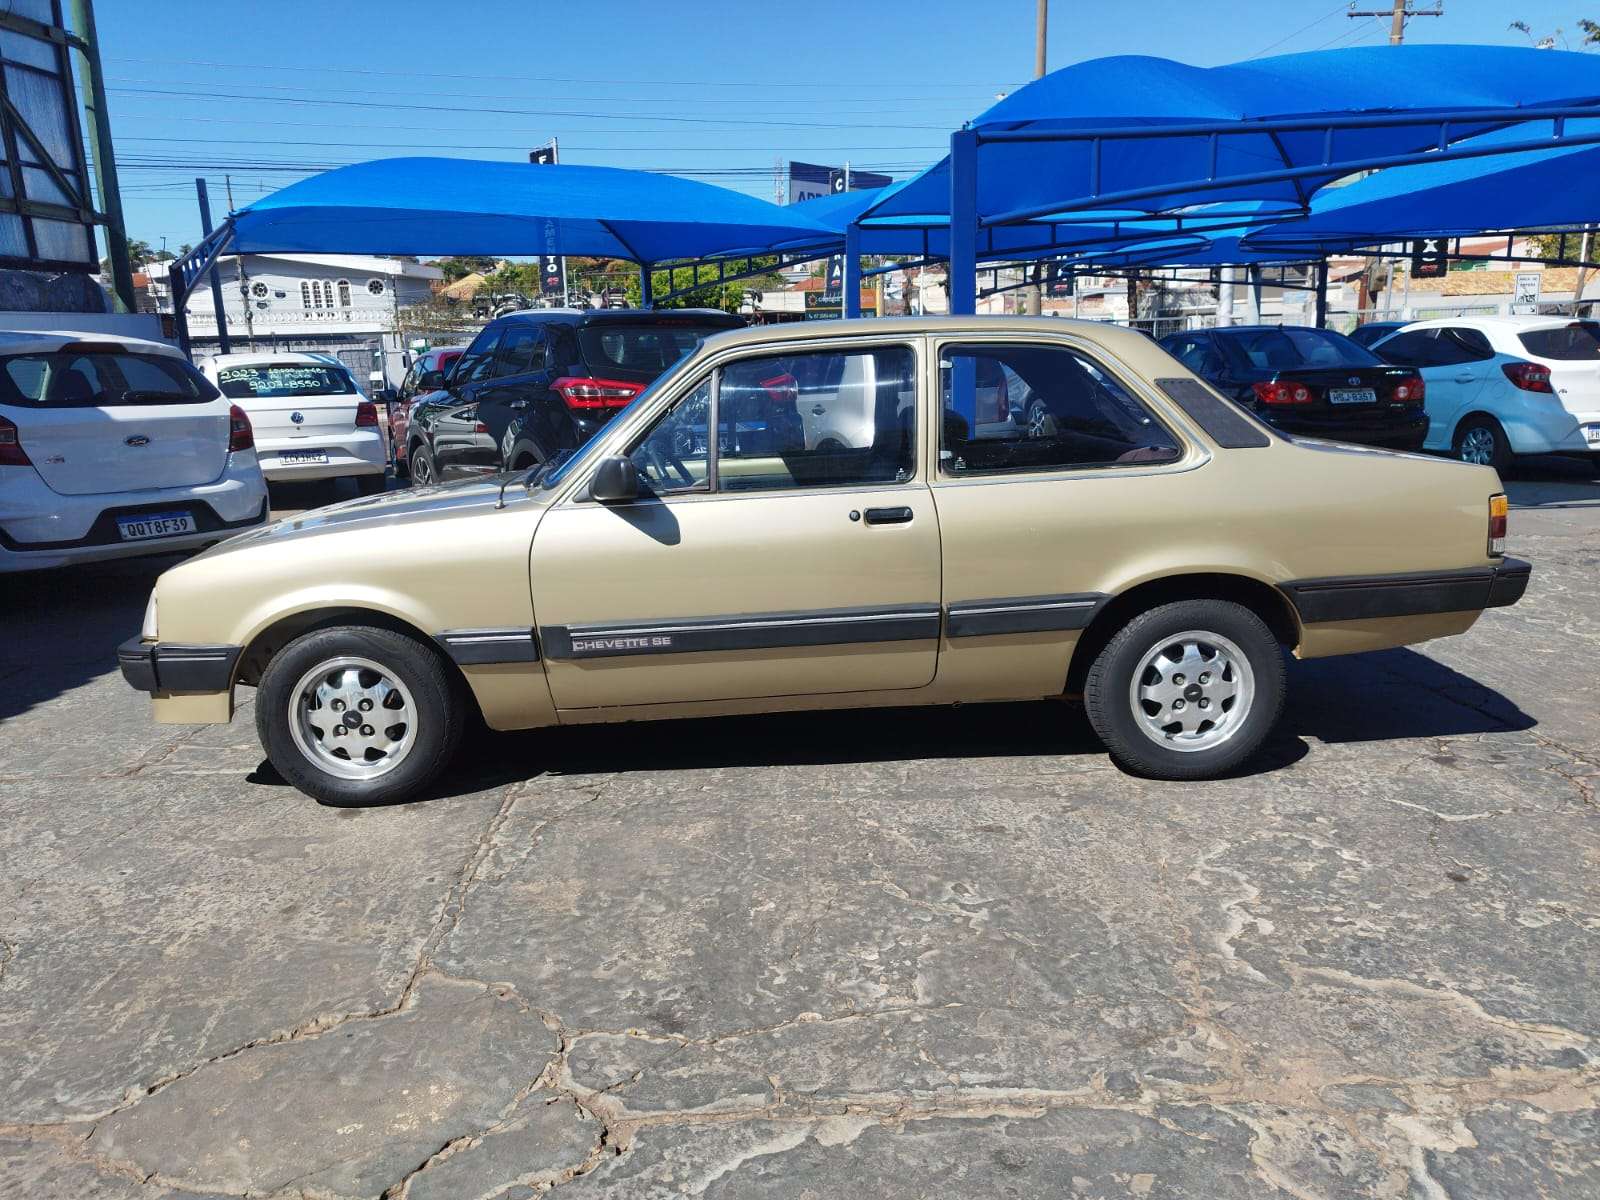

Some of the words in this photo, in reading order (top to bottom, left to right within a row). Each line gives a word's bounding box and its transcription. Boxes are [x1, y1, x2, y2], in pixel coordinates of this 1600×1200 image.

[220, 368, 259, 379] 2023
[127, 518, 188, 536] QQT8F39
[572, 638, 648, 652] CHEVETTE
[652, 636, 672, 646] SE
